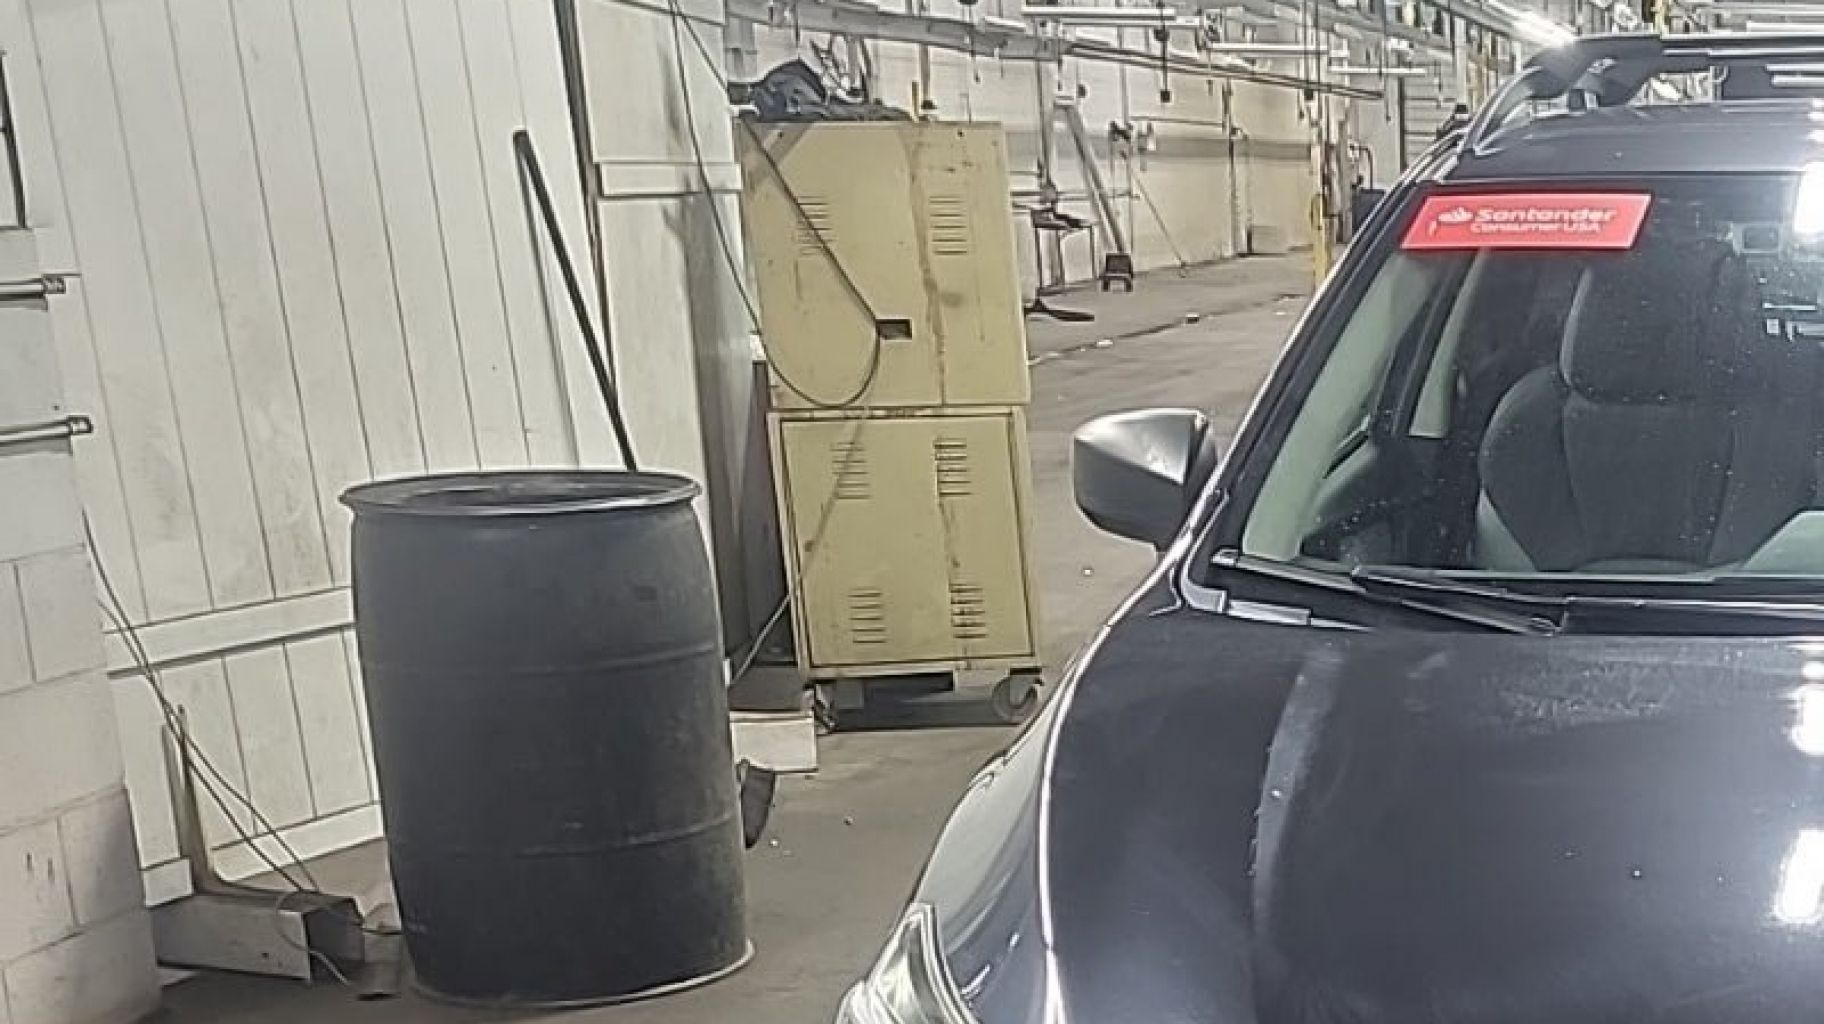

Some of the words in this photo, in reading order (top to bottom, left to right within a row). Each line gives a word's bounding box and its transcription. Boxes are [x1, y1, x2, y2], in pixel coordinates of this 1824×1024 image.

[1473, 206, 1617, 223] Santander
[1470, 221, 1562, 234] Consumer
[1564, 221, 1602, 233] USA
